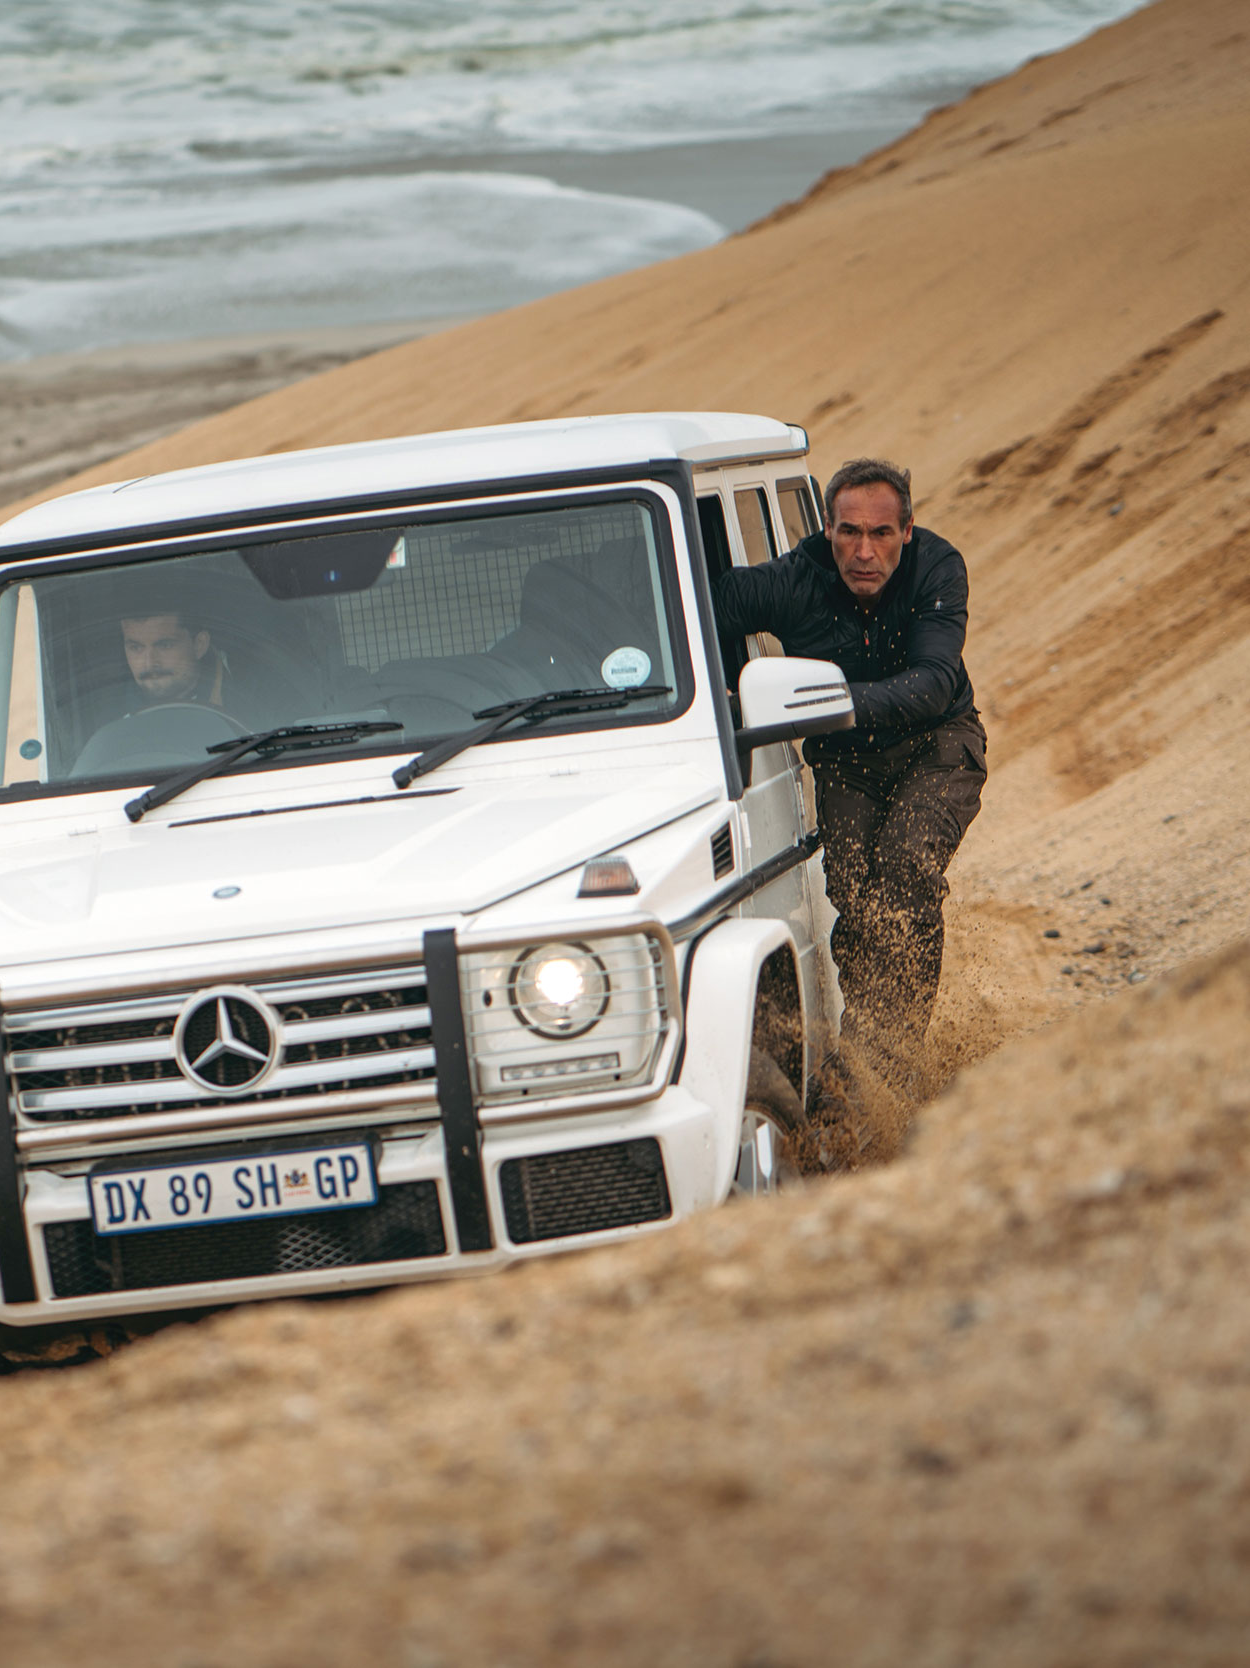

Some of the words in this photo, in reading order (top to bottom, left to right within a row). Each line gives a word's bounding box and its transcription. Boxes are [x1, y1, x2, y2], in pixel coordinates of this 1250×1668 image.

[102, 1178, 150, 1224] DX
[169, 1172, 212, 1216] 89
[233, 1162, 282, 1208] SH
[314, 1155, 360, 1200] GP
